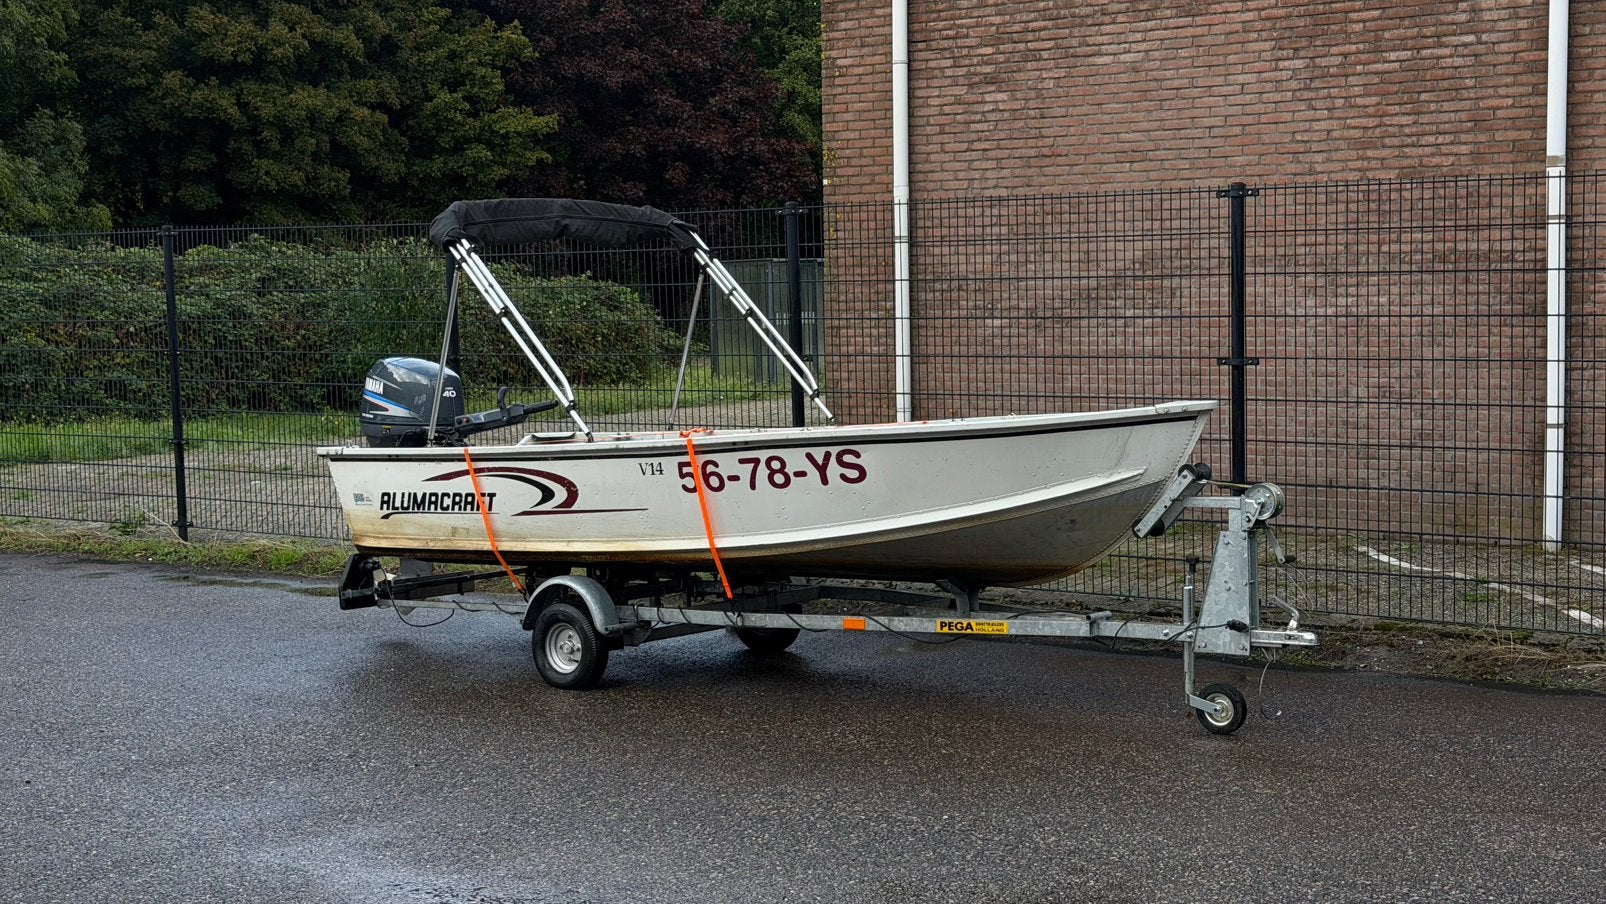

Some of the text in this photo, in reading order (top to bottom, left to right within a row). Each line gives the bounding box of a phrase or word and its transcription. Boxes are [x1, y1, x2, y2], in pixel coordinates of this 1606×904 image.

[442, 390, 457, 398] 40
[638, 462, 664, 476] V14
[677, 448, 868, 494] 56-78-YS
[939, 621, 975, 632] PEGA
